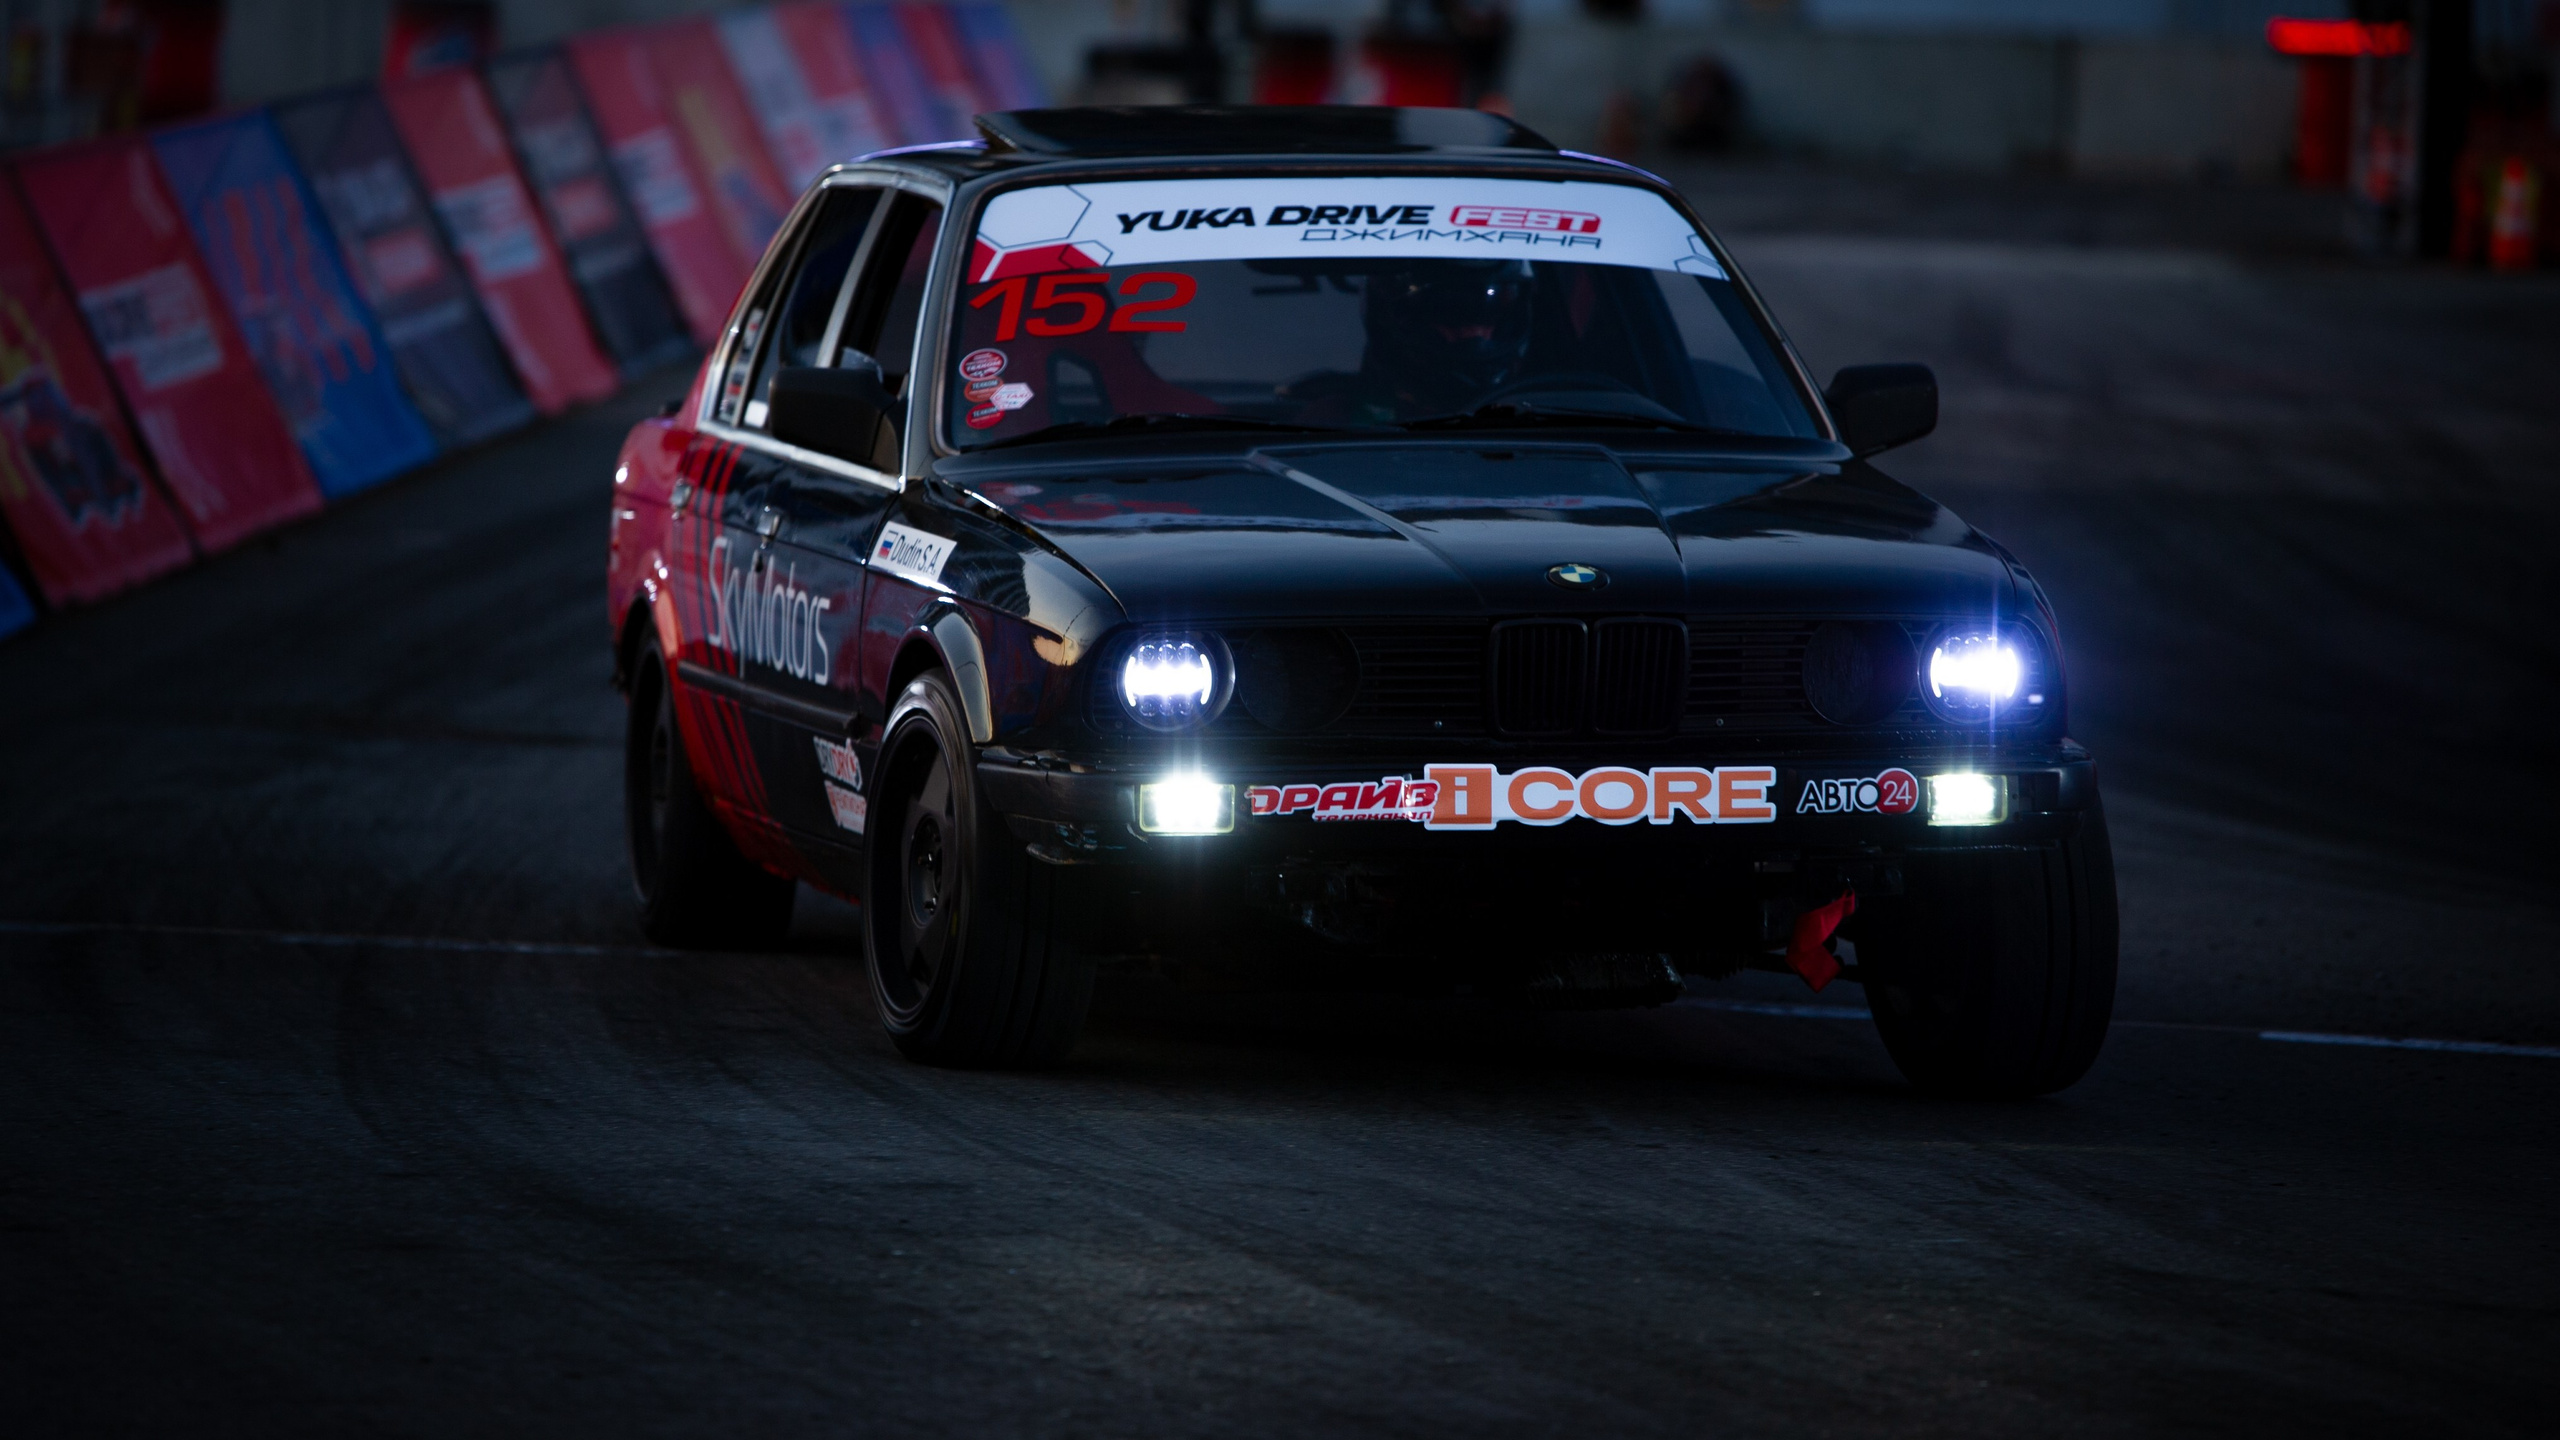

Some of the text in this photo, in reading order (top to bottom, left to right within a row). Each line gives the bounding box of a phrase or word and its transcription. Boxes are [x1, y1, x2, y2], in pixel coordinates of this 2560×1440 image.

[1117, 205, 1599, 234] YUKA DRIVE FEST
[1300, 228, 1602, 249] ДЖИМХАНА
[969, 272, 1198, 343] 152
[890, 535, 942, 576] Dudin S.A.
[707, 535, 831, 687] SkyMotors
